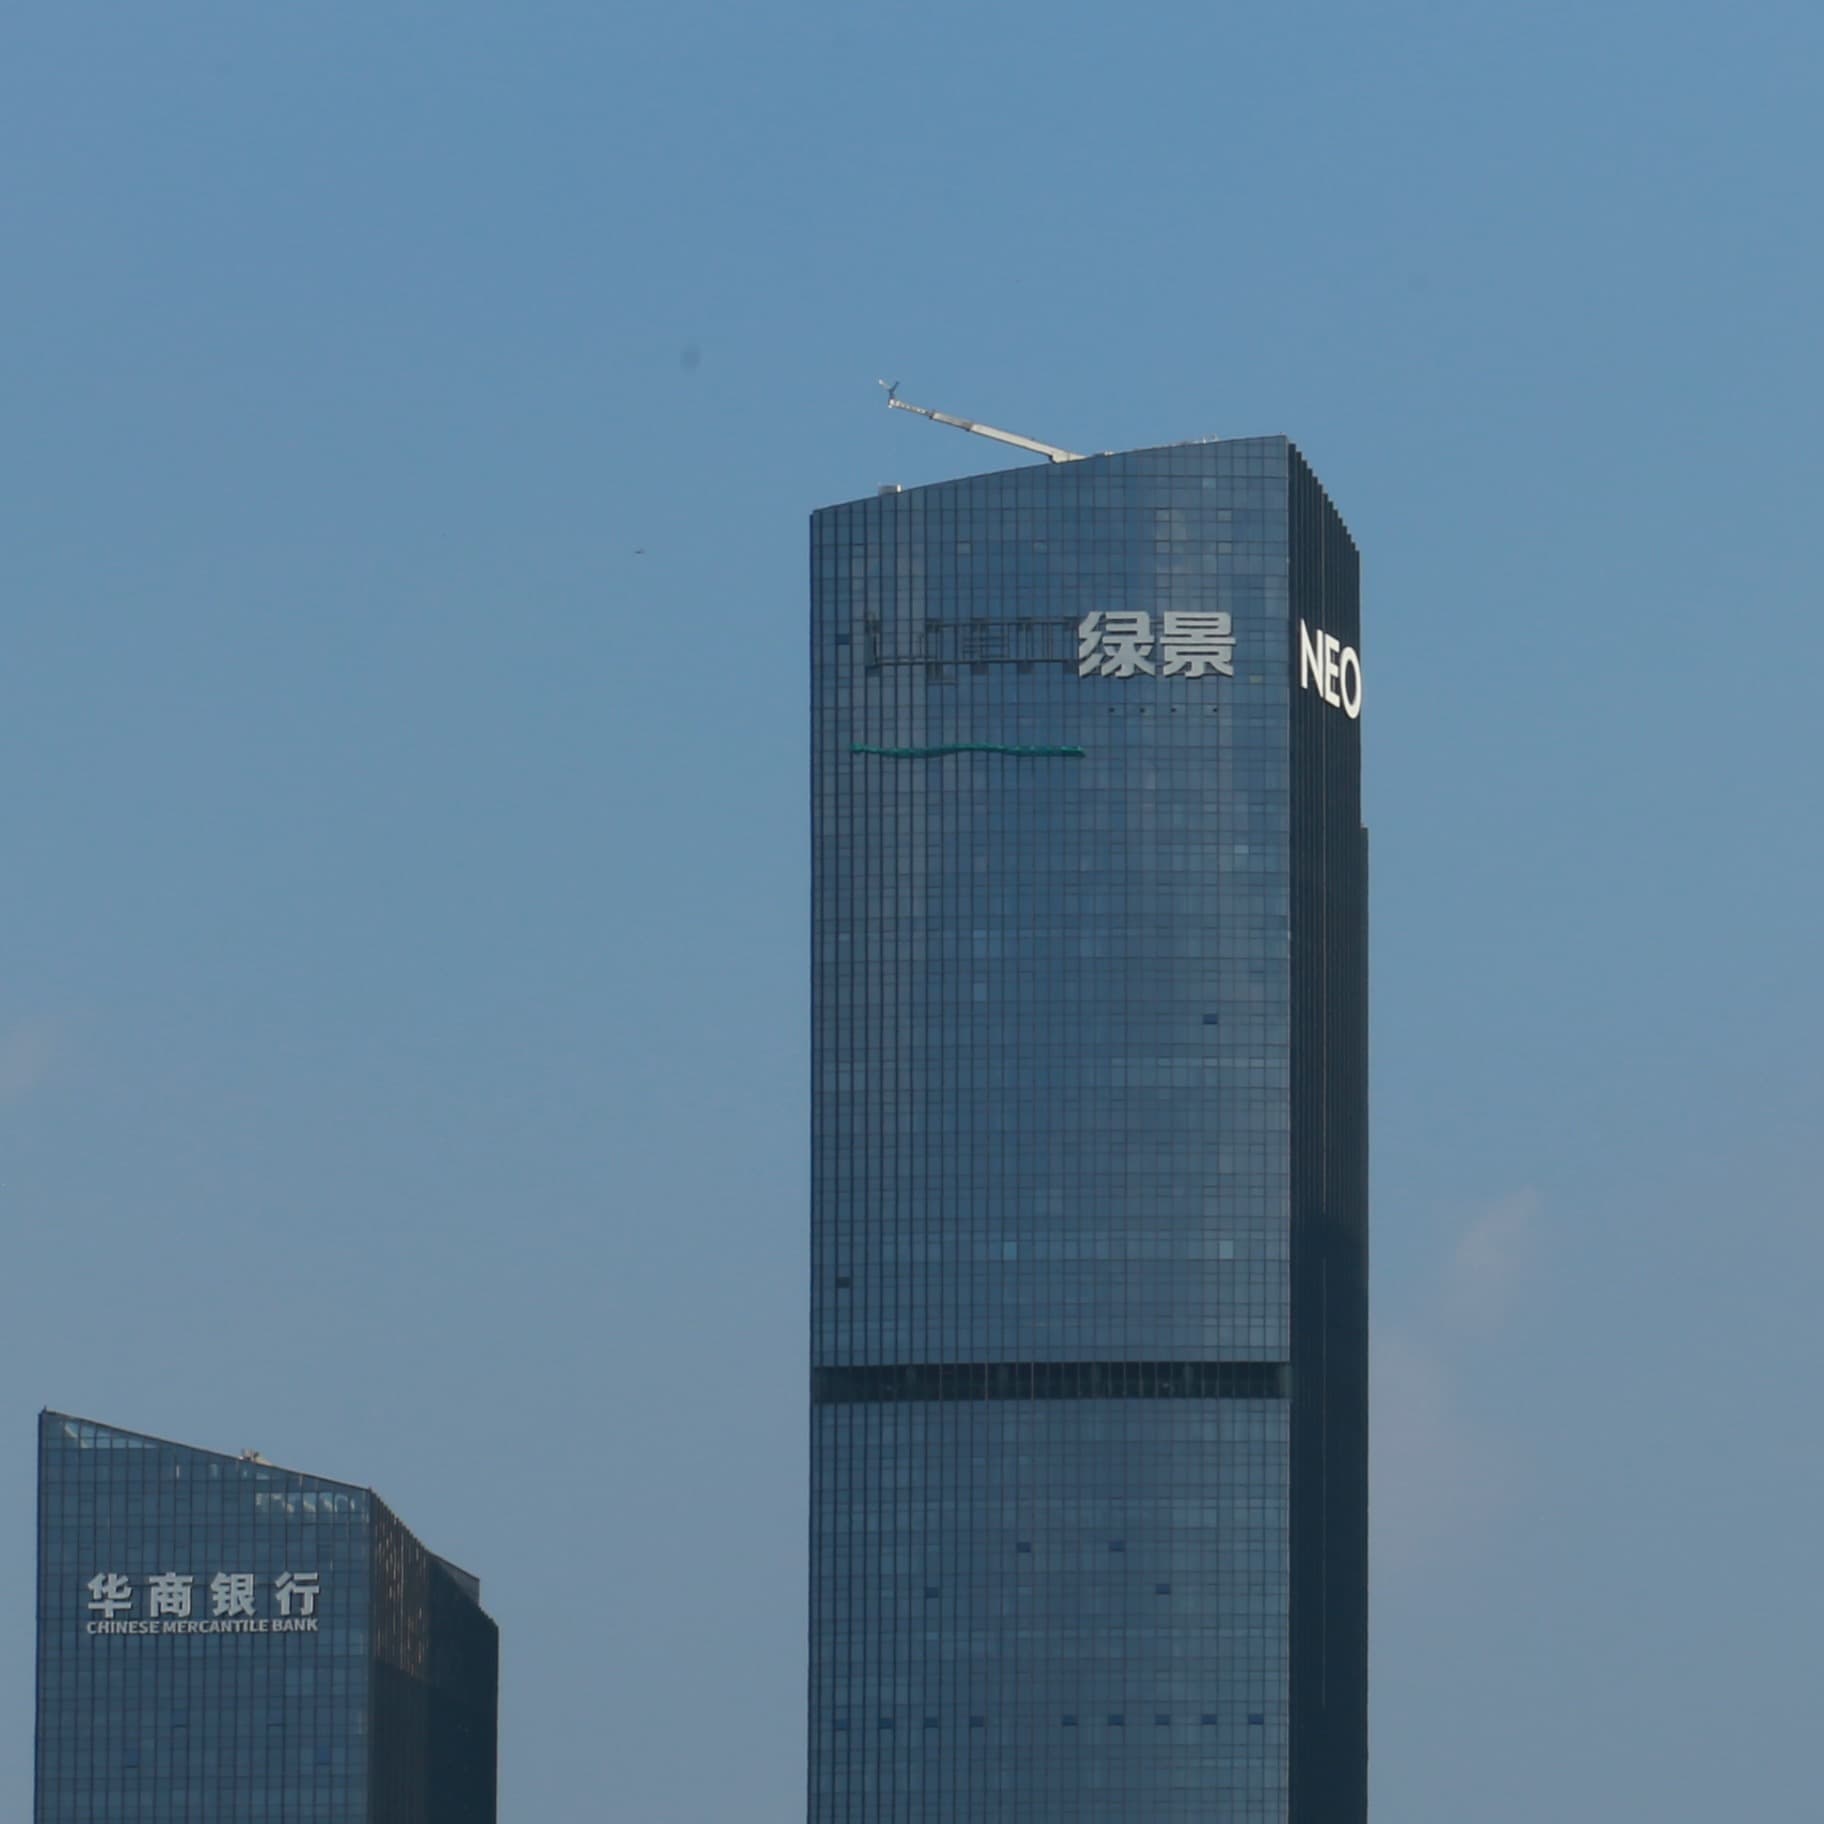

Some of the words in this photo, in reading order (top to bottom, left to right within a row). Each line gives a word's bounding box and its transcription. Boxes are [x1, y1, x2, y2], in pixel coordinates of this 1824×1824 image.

[1078, 610, 1237, 678] 绿景
[1300, 617, 1362, 720] NEO
[87, 1570, 321, 1619] 华商银行
[87, 1619, 160, 1635] CHINESE
[162, 1618, 269, 1634] MERCANTILE
[271, 1617, 319, 1633] BANK
